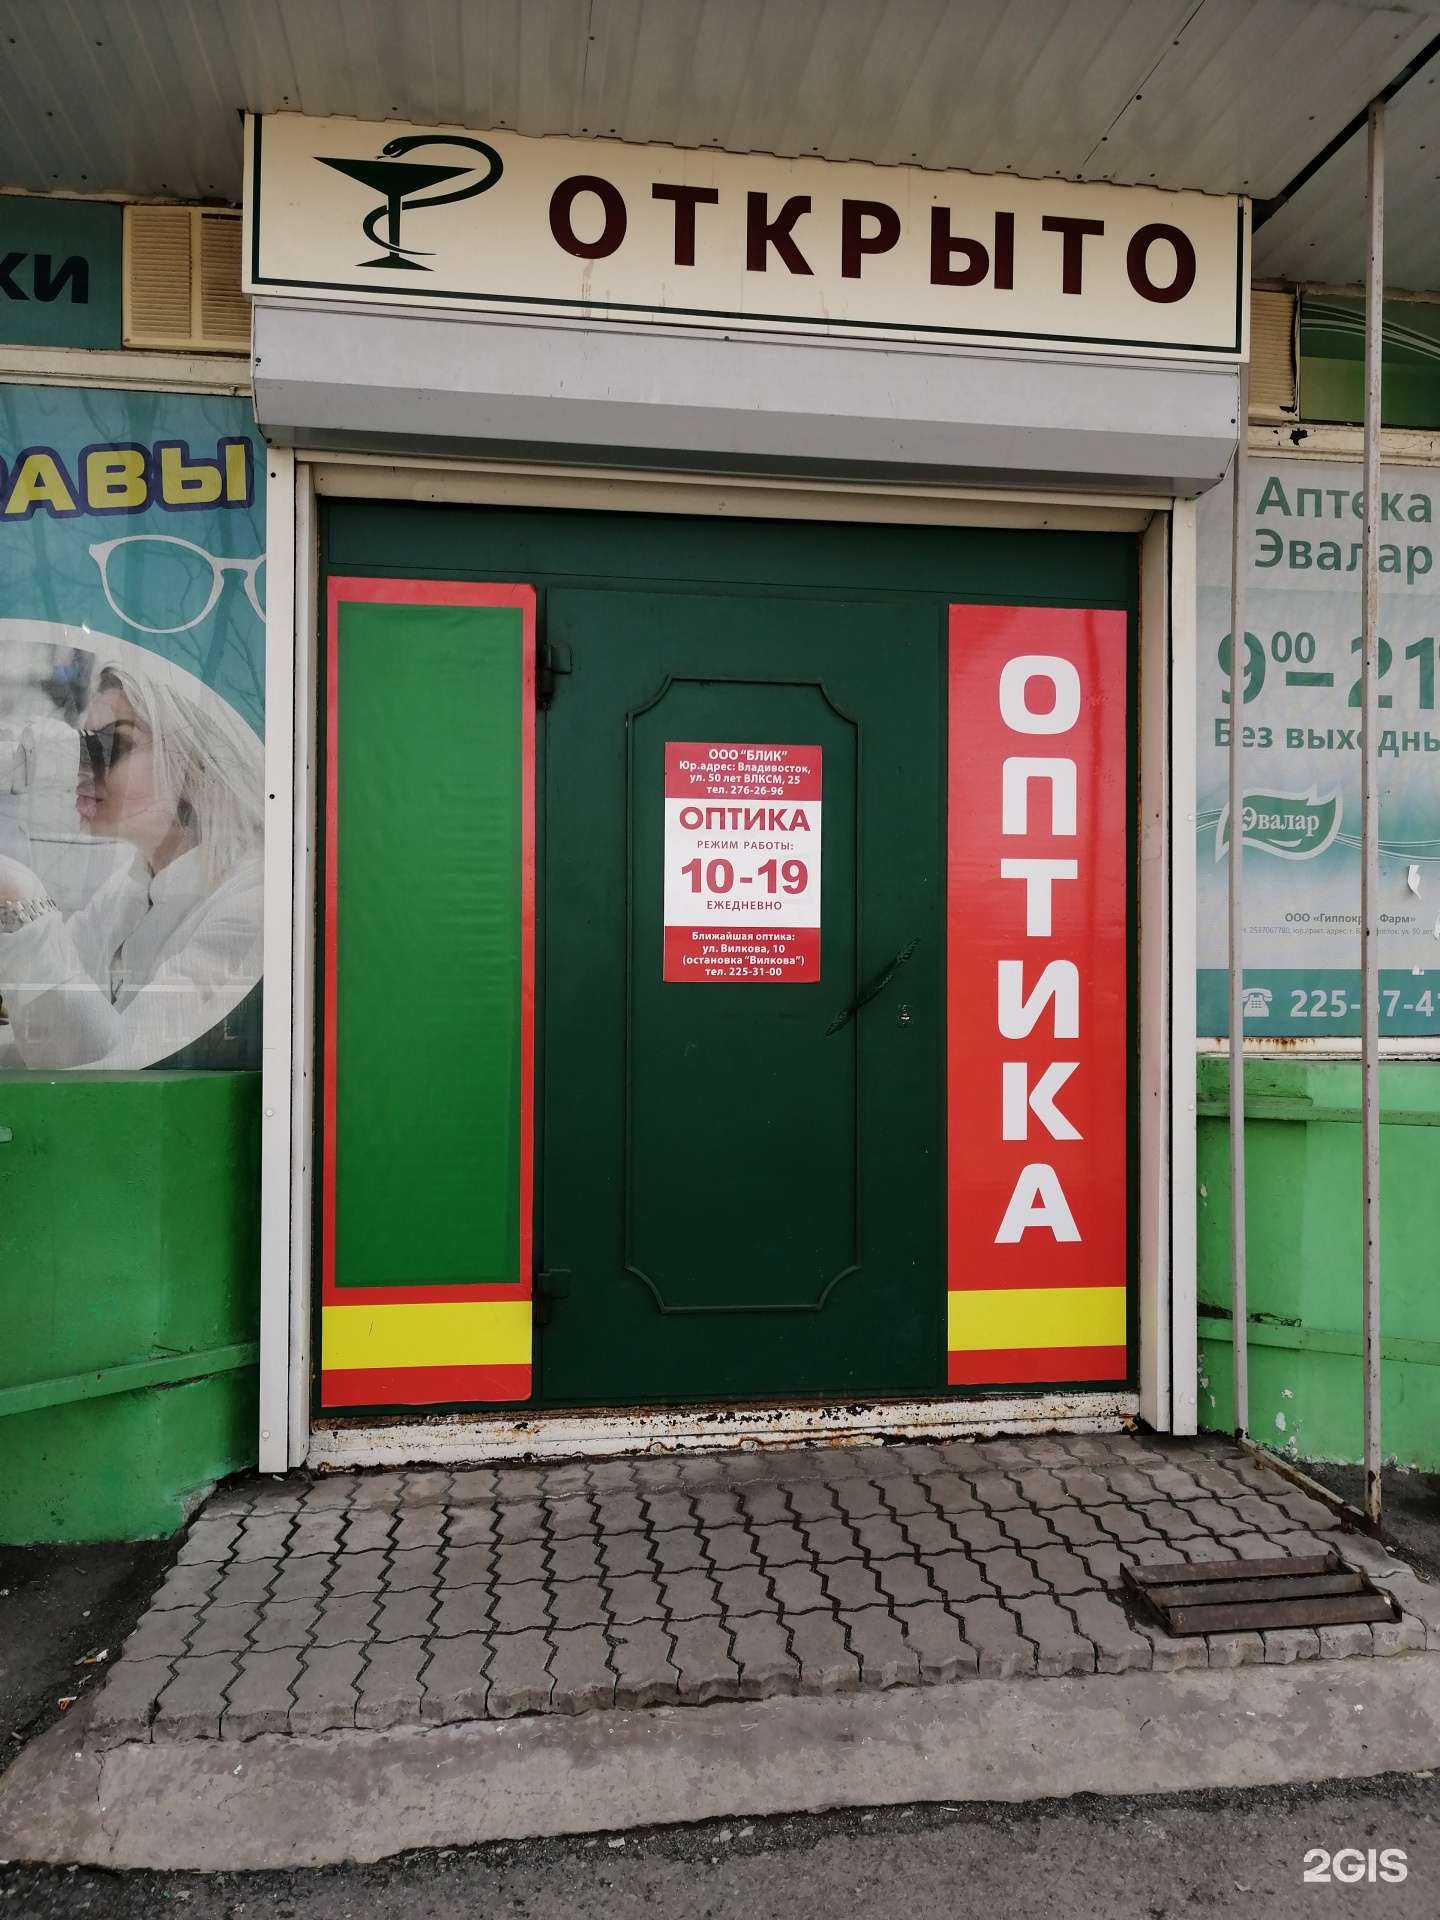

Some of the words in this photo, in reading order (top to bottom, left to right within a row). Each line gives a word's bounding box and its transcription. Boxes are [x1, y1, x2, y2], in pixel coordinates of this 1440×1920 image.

[548, 175, 1196, 303] ОТКРЫТО
[0, 438, 253, 520] АВЫ
[1255, 476, 1432, 523] Аптека
[1255, 528, 1433, 585] Эвалар
[709, 749, 738, 760] ООО
[738, 763, 811, 774] Владивосток,
[690, 774, 705, 784] ул.
[708, 773, 721, 783] 50
[723, 775, 741, 783] лет
[744, 775, 785, 785] ВЛКСМ,
[788, 775, 801, 785] 25
[706, 786, 727, 794] тел.
[730, 785, 784, 795] 276-26-96
[679, 806, 811, 832] ОПТИКА
[697, 840, 738, 850] РЕЖИМ
[744, 841, 794, 851] РАБОТЫ:
[681, 858, 808, 895] 10-19
[707, 900, 783, 911] ЕЖЕДНЕВНО
[1285, 912, 1311, 922] ООО
[692, 931, 753, 941] Ближайшая
[755, 932, 795, 942] оптика:
[702, 945, 718, 955] ул.
[720, 944, 770, 955] Вилкова,
[773, 944, 785, 953] 10
[994, 655, 1084, 1243] ОПТИКА
[682, 955, 743, 966] (остановка
[705, 968, 726, 976] тел.
[728, 967, 783, 977] 225-31-00
[1290, 989, 1440, 1018] 225-7-4
